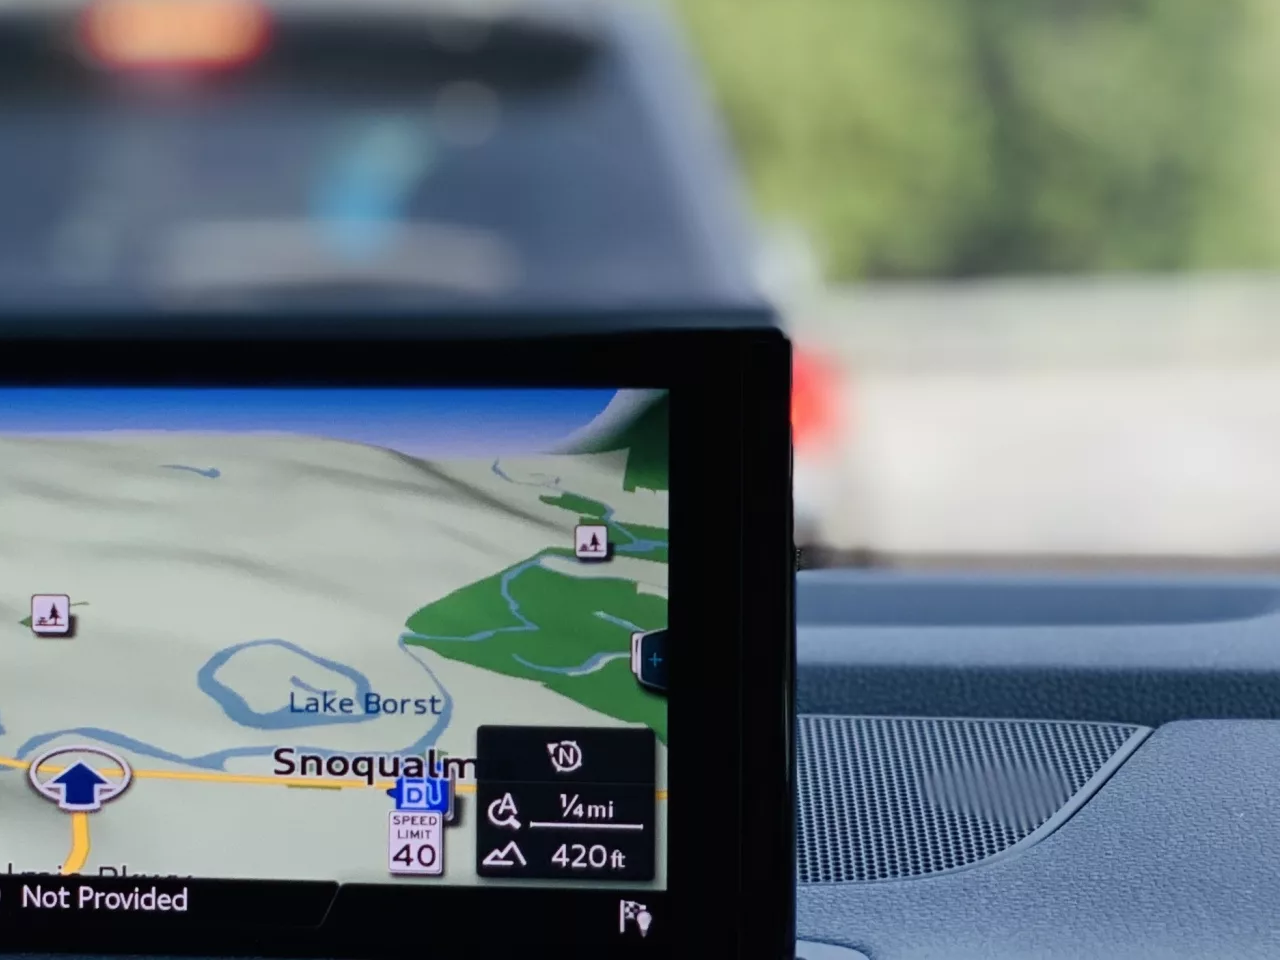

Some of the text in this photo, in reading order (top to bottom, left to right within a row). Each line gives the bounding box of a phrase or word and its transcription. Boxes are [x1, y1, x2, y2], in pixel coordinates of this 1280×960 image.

[289, 691, 442, 715] Lake Borst
[559, 747, 574, 765] N
[392, 815, 438, 826] SPEED
[397, 829, 432, 840] LIMIT
[392, 843, 437, 868] 40
[22, 884, 188, 912] Not Provided
